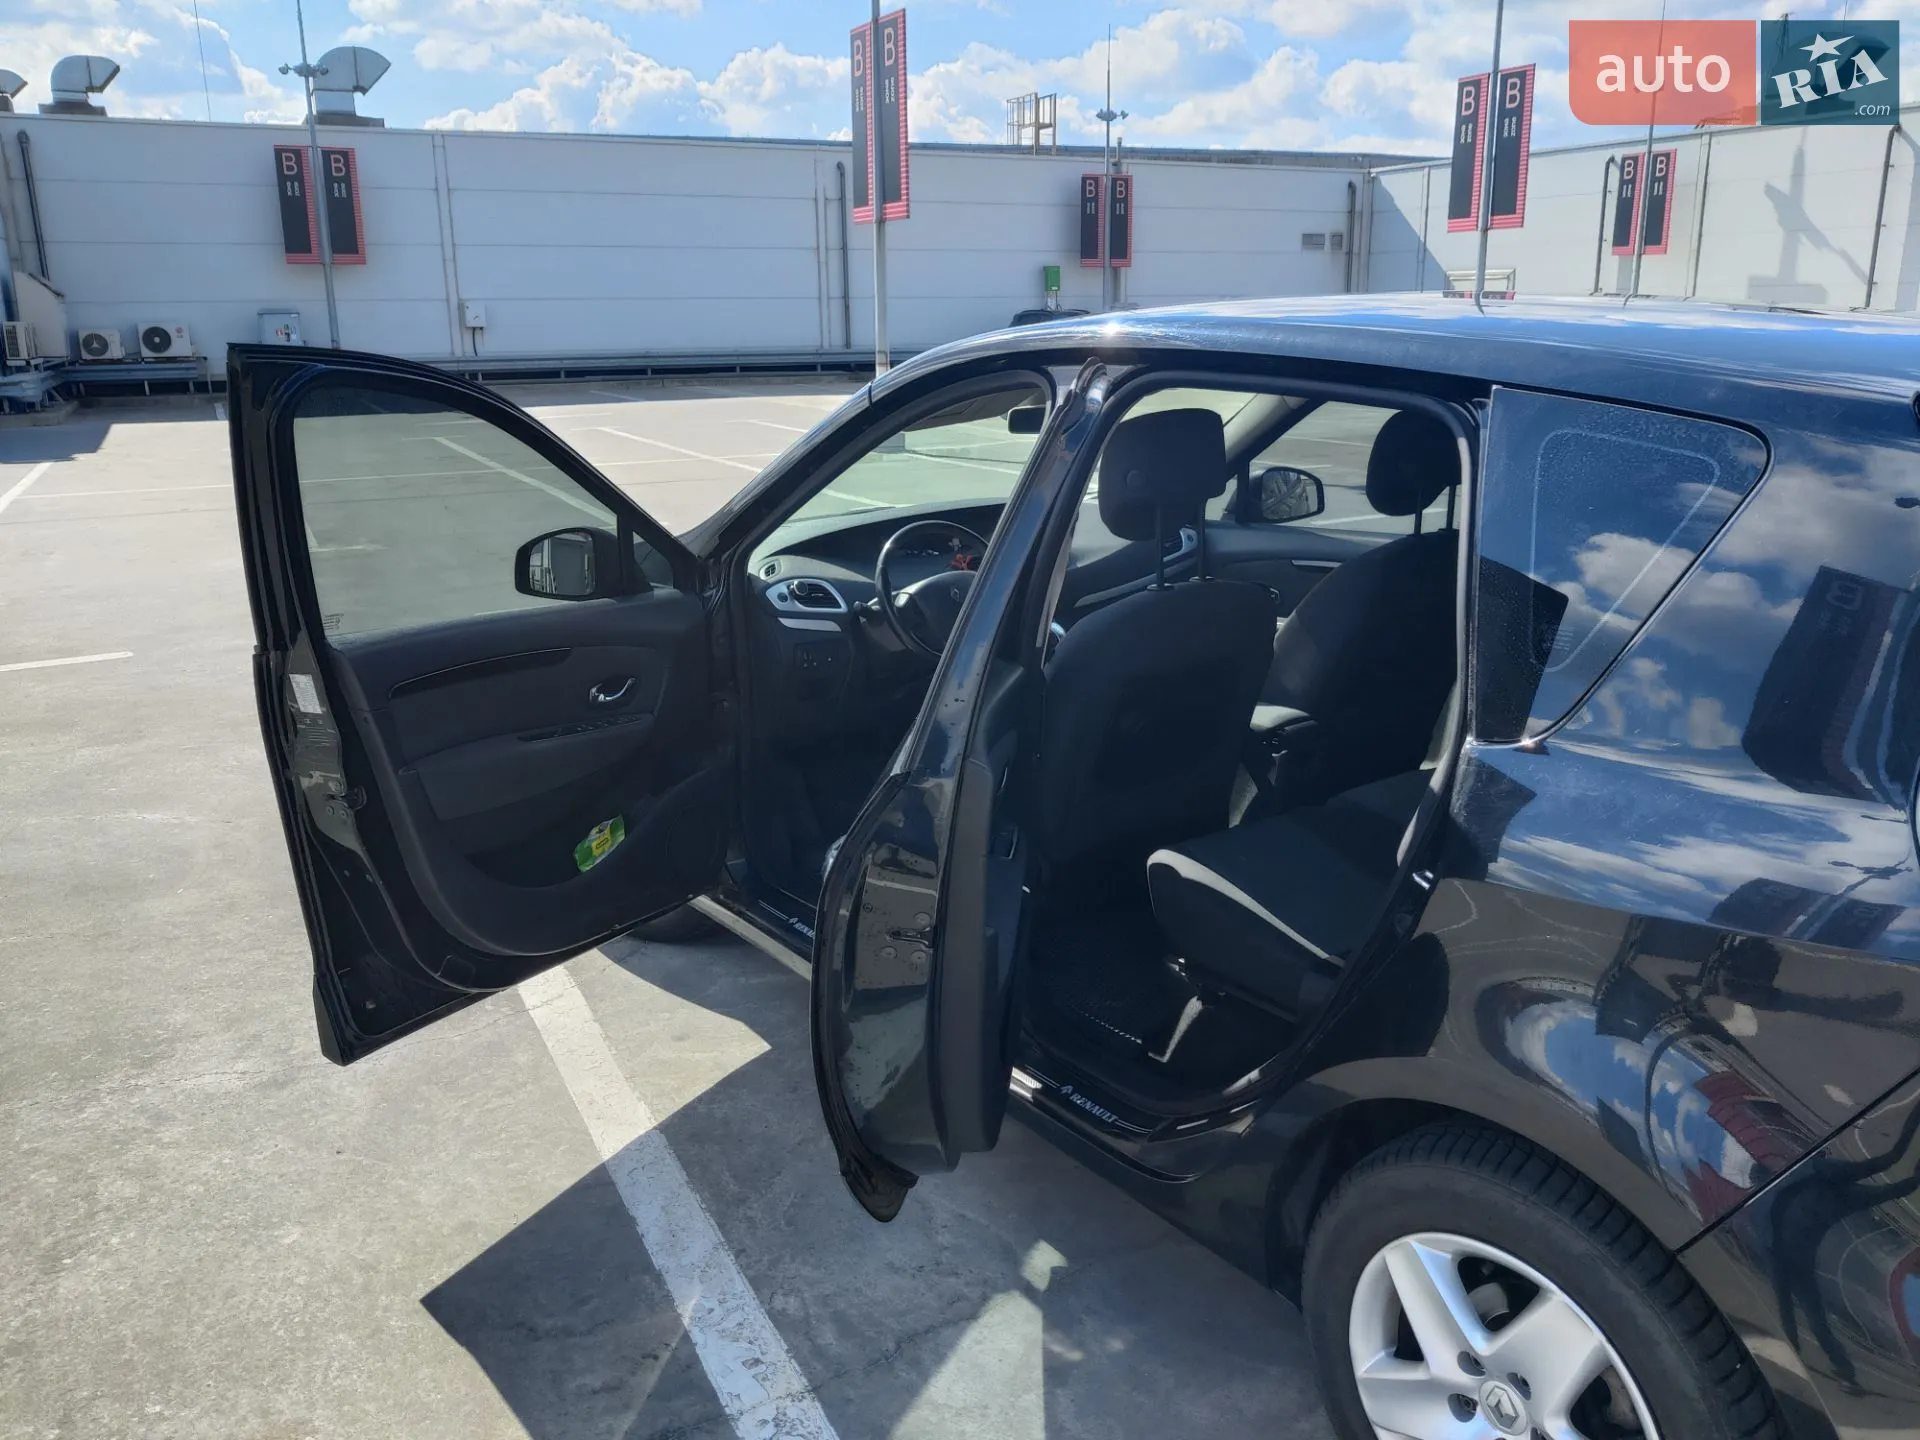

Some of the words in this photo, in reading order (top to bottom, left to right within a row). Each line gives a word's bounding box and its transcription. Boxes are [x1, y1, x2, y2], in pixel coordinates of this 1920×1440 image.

[853, 39, 864, 77] B
[884, 27, 896, 66] B
[1461, 86, 1475, 116] B
[1505, 77, 1521, 108] B
[281, 152, 298, 175] B
[330, 153, 346, 176] B
[1623, 160, 1634, 180] B
[1655, 156, 1667, 177] B
[1086, 180, 1096, 198] B
[1116, 181, 1126, 198] B
[1069, 1093, 1119, 1123] RENAULT
